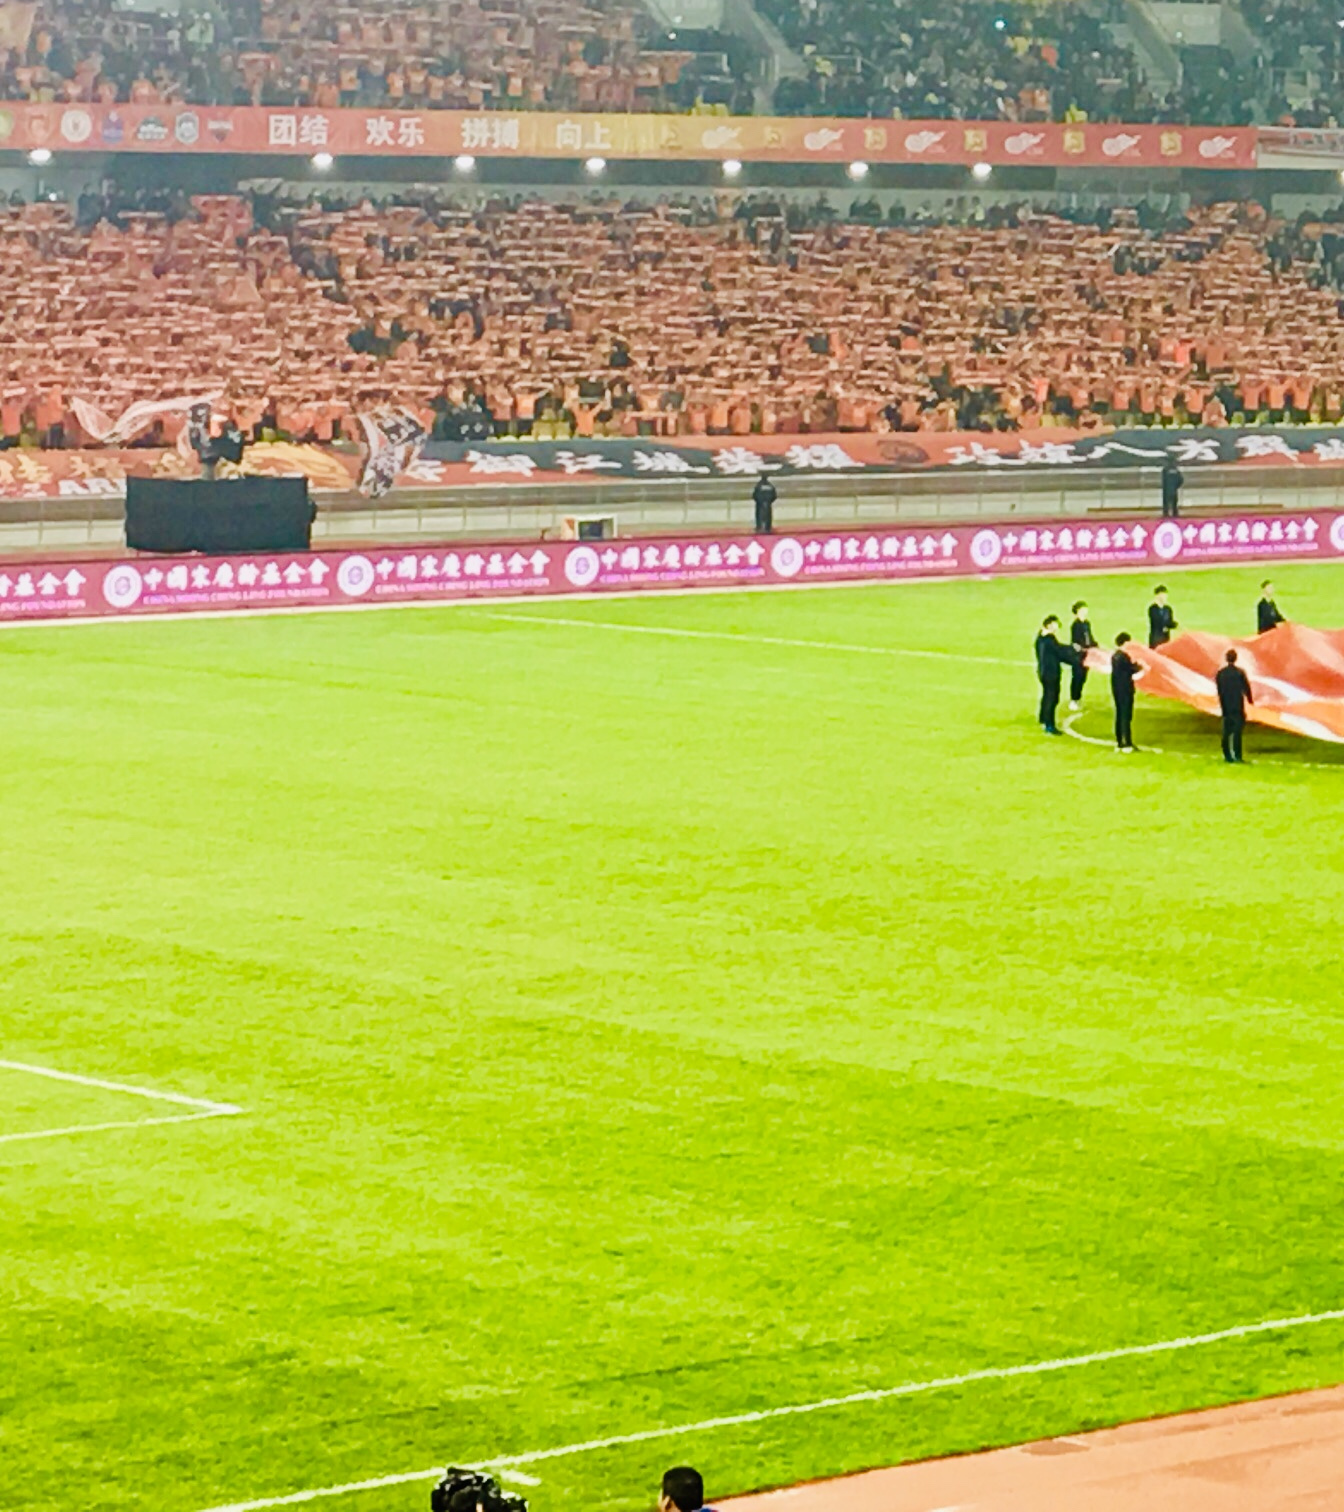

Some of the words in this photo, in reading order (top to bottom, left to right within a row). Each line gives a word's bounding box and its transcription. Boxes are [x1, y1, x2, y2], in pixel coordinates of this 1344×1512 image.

[268, 114, 329, 146] 团结
[366, 117, 425, 148] 欢乐
[461, 118, 520, 150] 拼搏
[556, 120, 612, 150] 向上
